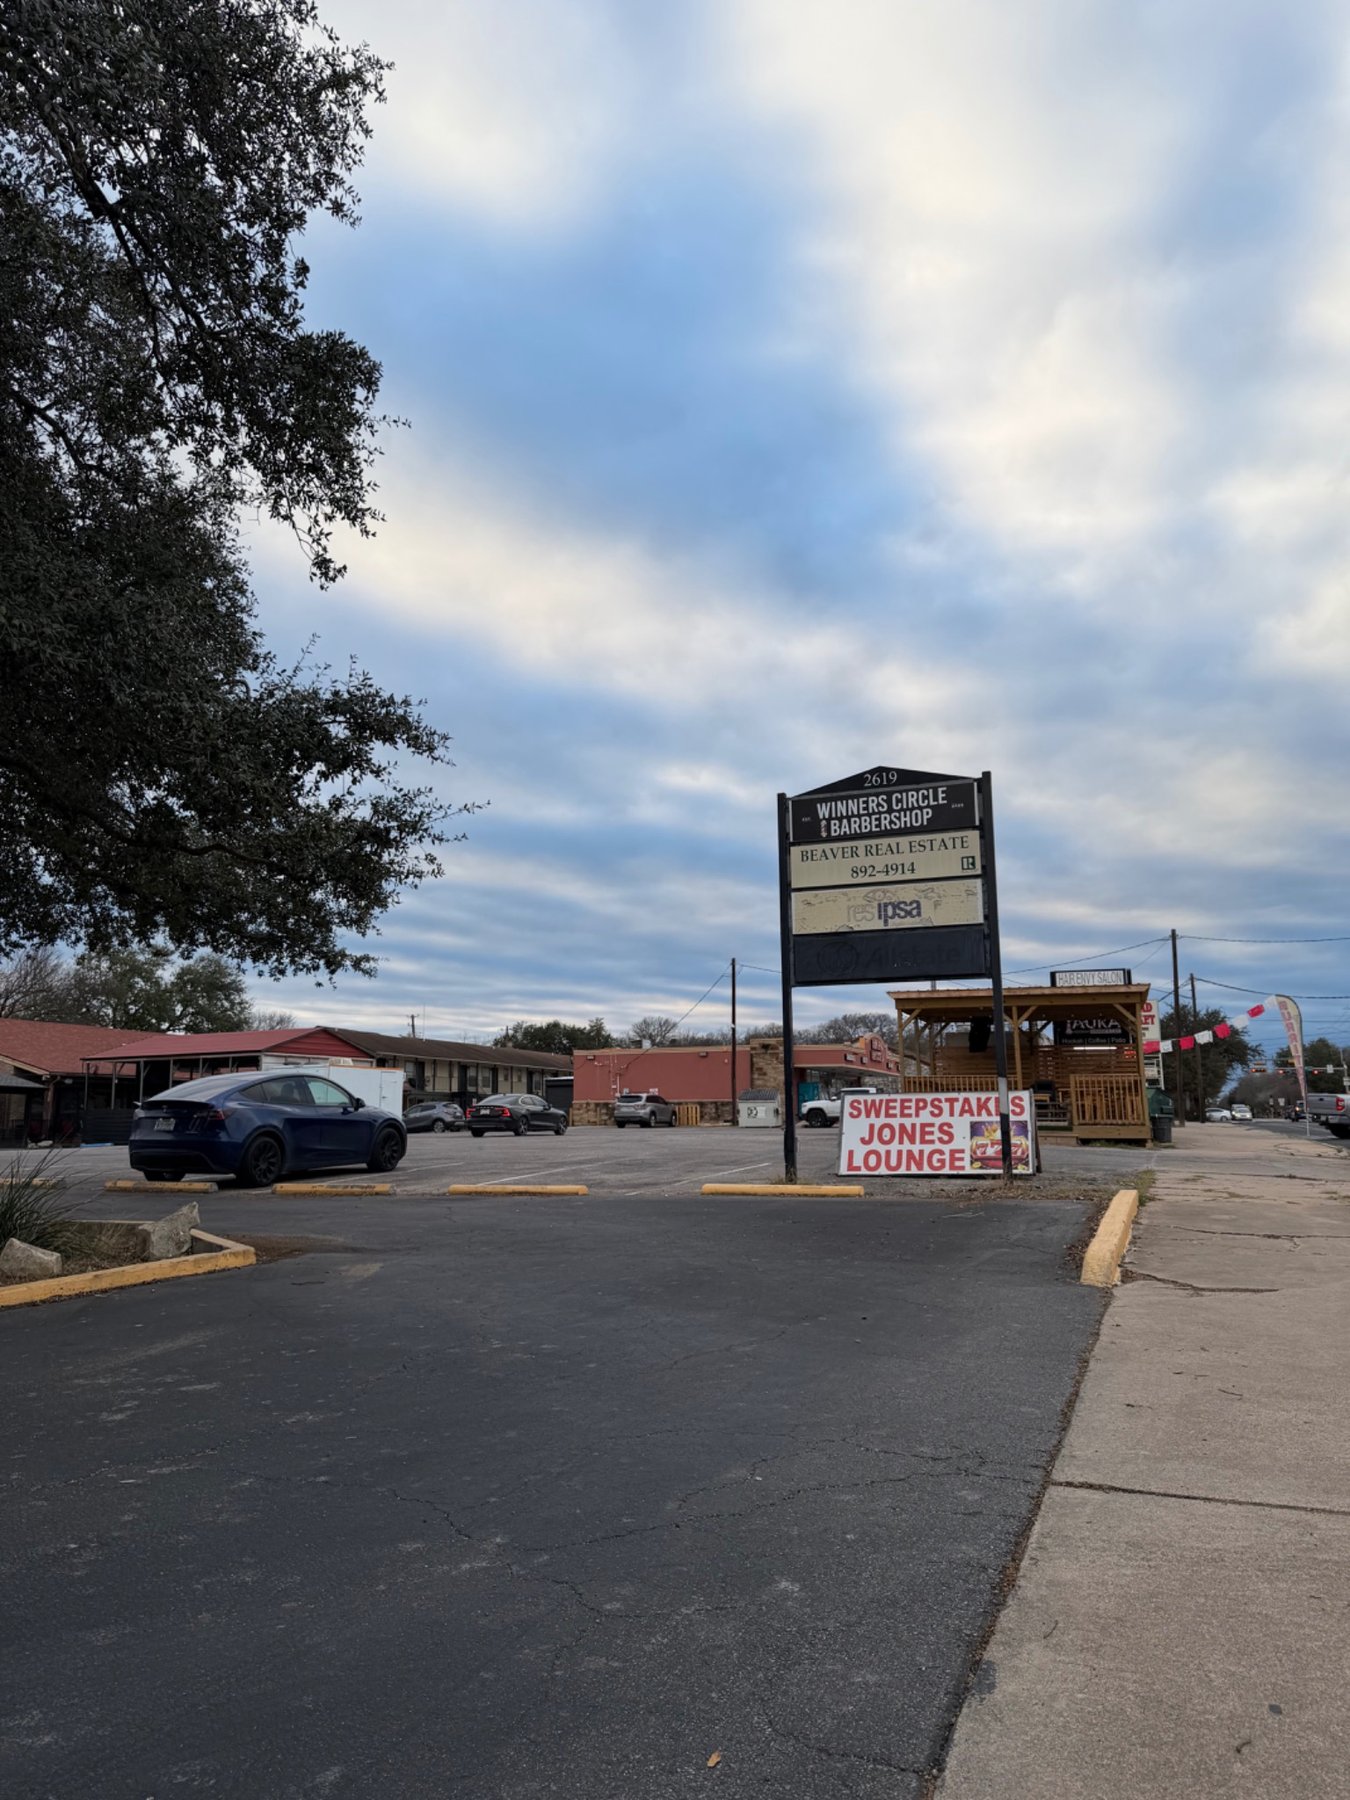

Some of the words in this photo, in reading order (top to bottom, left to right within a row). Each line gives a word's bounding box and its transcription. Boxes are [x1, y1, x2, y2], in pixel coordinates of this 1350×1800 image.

[863, 771, 898, 787] 2619
[816, 795, 887, 820] WINNERS
[892, 787, 948, 809] CIRCLE
[830, 808, 933, 837] BARBERSHOP
[800, 845, 860, 863] BEAVER
[864, 841, 904, 857] REAL
[908, 835, 969, 851] ESTATE
[850, 861, 916, 879] 892-4914
[877, 899, 922, 927] ipsa
[1097, 971, 1122, 984] SALON
[859, 1122, 955, 1146] JONES
[846, 1148, 966, 1173] LOUNGE
